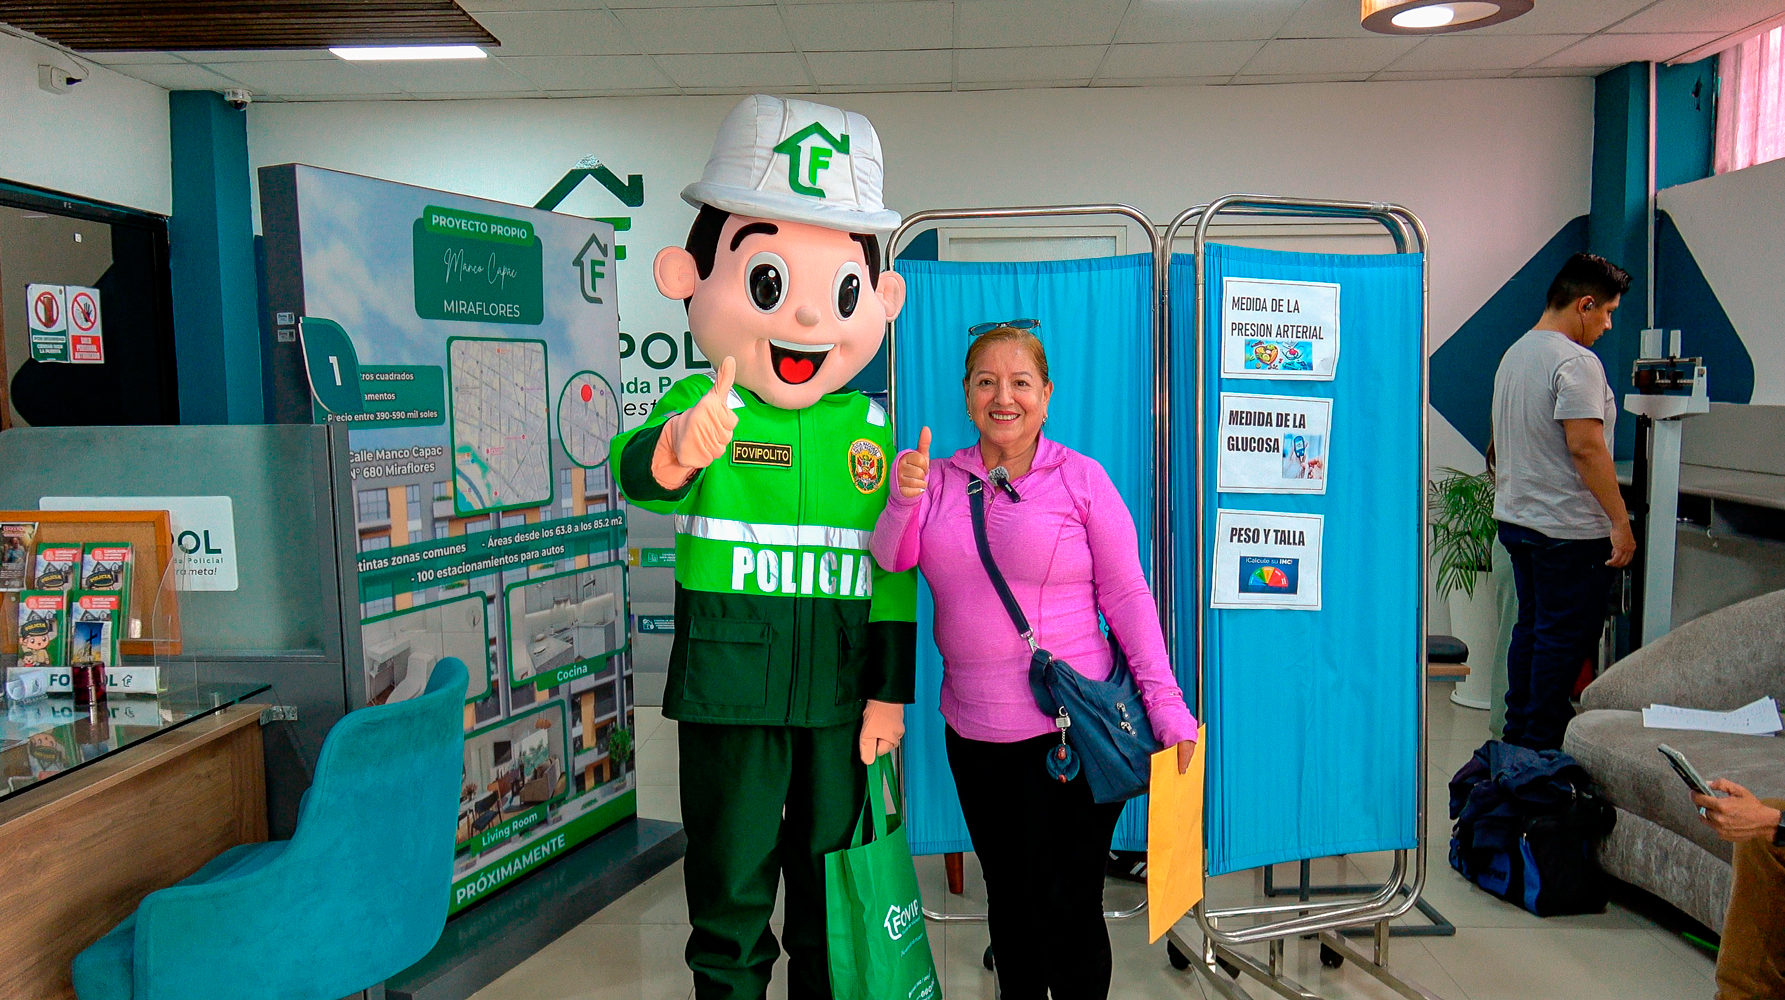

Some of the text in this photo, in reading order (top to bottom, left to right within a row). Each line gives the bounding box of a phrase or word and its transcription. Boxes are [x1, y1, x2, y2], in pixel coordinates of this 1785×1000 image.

[807, 146, 833, 186] F
[431, 214, 528, 239] PROYECTO PROPIO
[444, 248, 484, 283] Manco
[444, 300, 520, 317] MIRAFLORES
[1231, 296, 1300, 314] MEDIDA DE LA
[1231, 322, 1324, 340] PRESION ARTERIAL
[328, 356, 342, 386] 1
[361, 372, 414, 381] ros cuadrados
[354, 413, 375, 421] entre
[376, 411, 406, 420] 390-590
[407, 409, 419, 419] mil
[420, 410, 438, 419] soles
[1228, 410, 1306, 429] MEDIDA DE LA
[735, 446, 789, 461] FOVIPOLITO
[1227, 436, 1280, 453] GLUCOSA
[349, 450, 374, 463] Calle
[376, 448, 410, 460] Manco
[412, 446, 443, 459] Capac
[363, 466, 383, 479] 680
[385, 462, 435, 476] Miraflores
[487, 535, 513, 548] Áreas
[514, 532, 540, 543] desde
[542, 528, 554, 539] los
[555, 524, 573, 536] 63.8
[580, 522, 592, 531] los
[593, 519, 610, 529] 85.2
[611, 516, 623, 526] m2
[1229, 527, 1306, 546] PESO Y TALLA
[171, 530, 222, 554] OL
[357, 543, 467, 572] tintas zonas comunes
[416, 570, 435, 583] 100
[436, 554, 519, 579] estacionamientos
[520, 550, 540, 563] para
[541, 544, 565, 557] autos
[731, 546, 873, 597] POLICIA
[556, 664, 588, 682] Cocina
[481, 812, 538, 847] Living Room
[455, 833, 566, 905] PRÓXIMAMENTE
